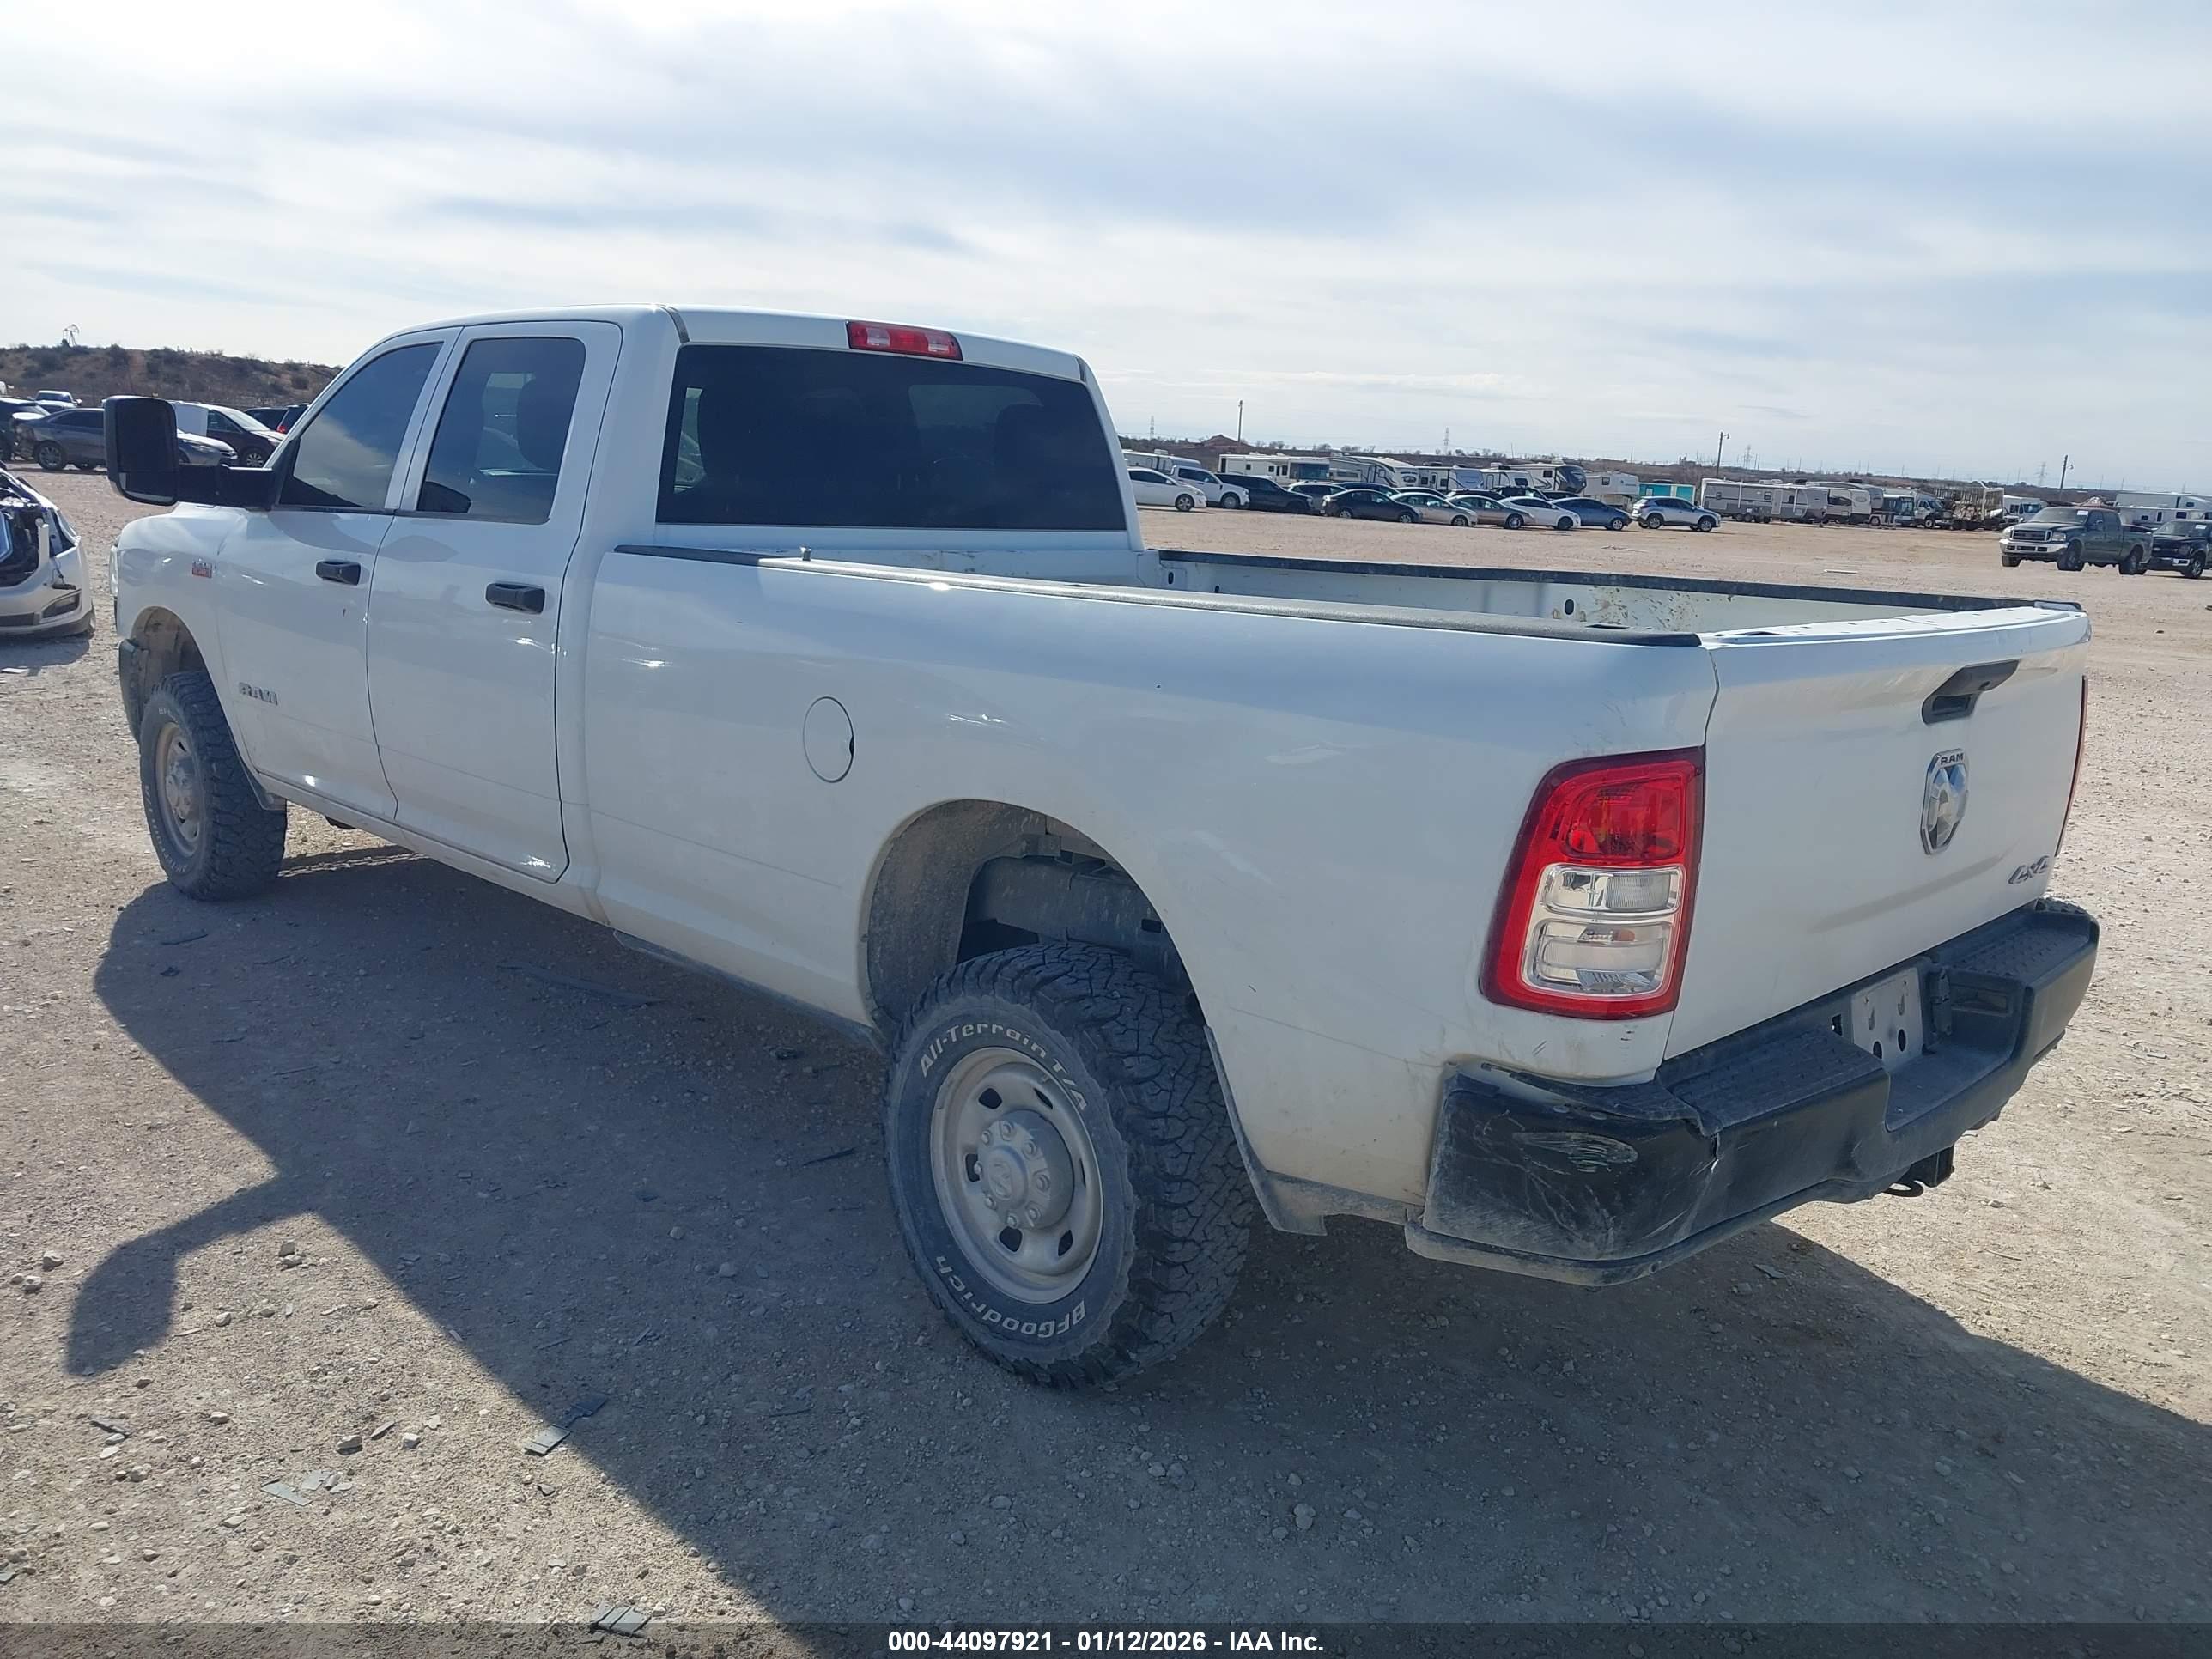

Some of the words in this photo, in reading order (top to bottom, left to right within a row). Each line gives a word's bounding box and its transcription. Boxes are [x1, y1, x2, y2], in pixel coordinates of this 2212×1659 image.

[239, 682, 278, 706] RAM
[1940, 752, 1964, 765] RAM
[920, 1022, 1047, 1078] All-Terrain
[1052, 1058, 1087, 1110] T/A
[935, 1255, 1086, 1339] BFGoodrich
